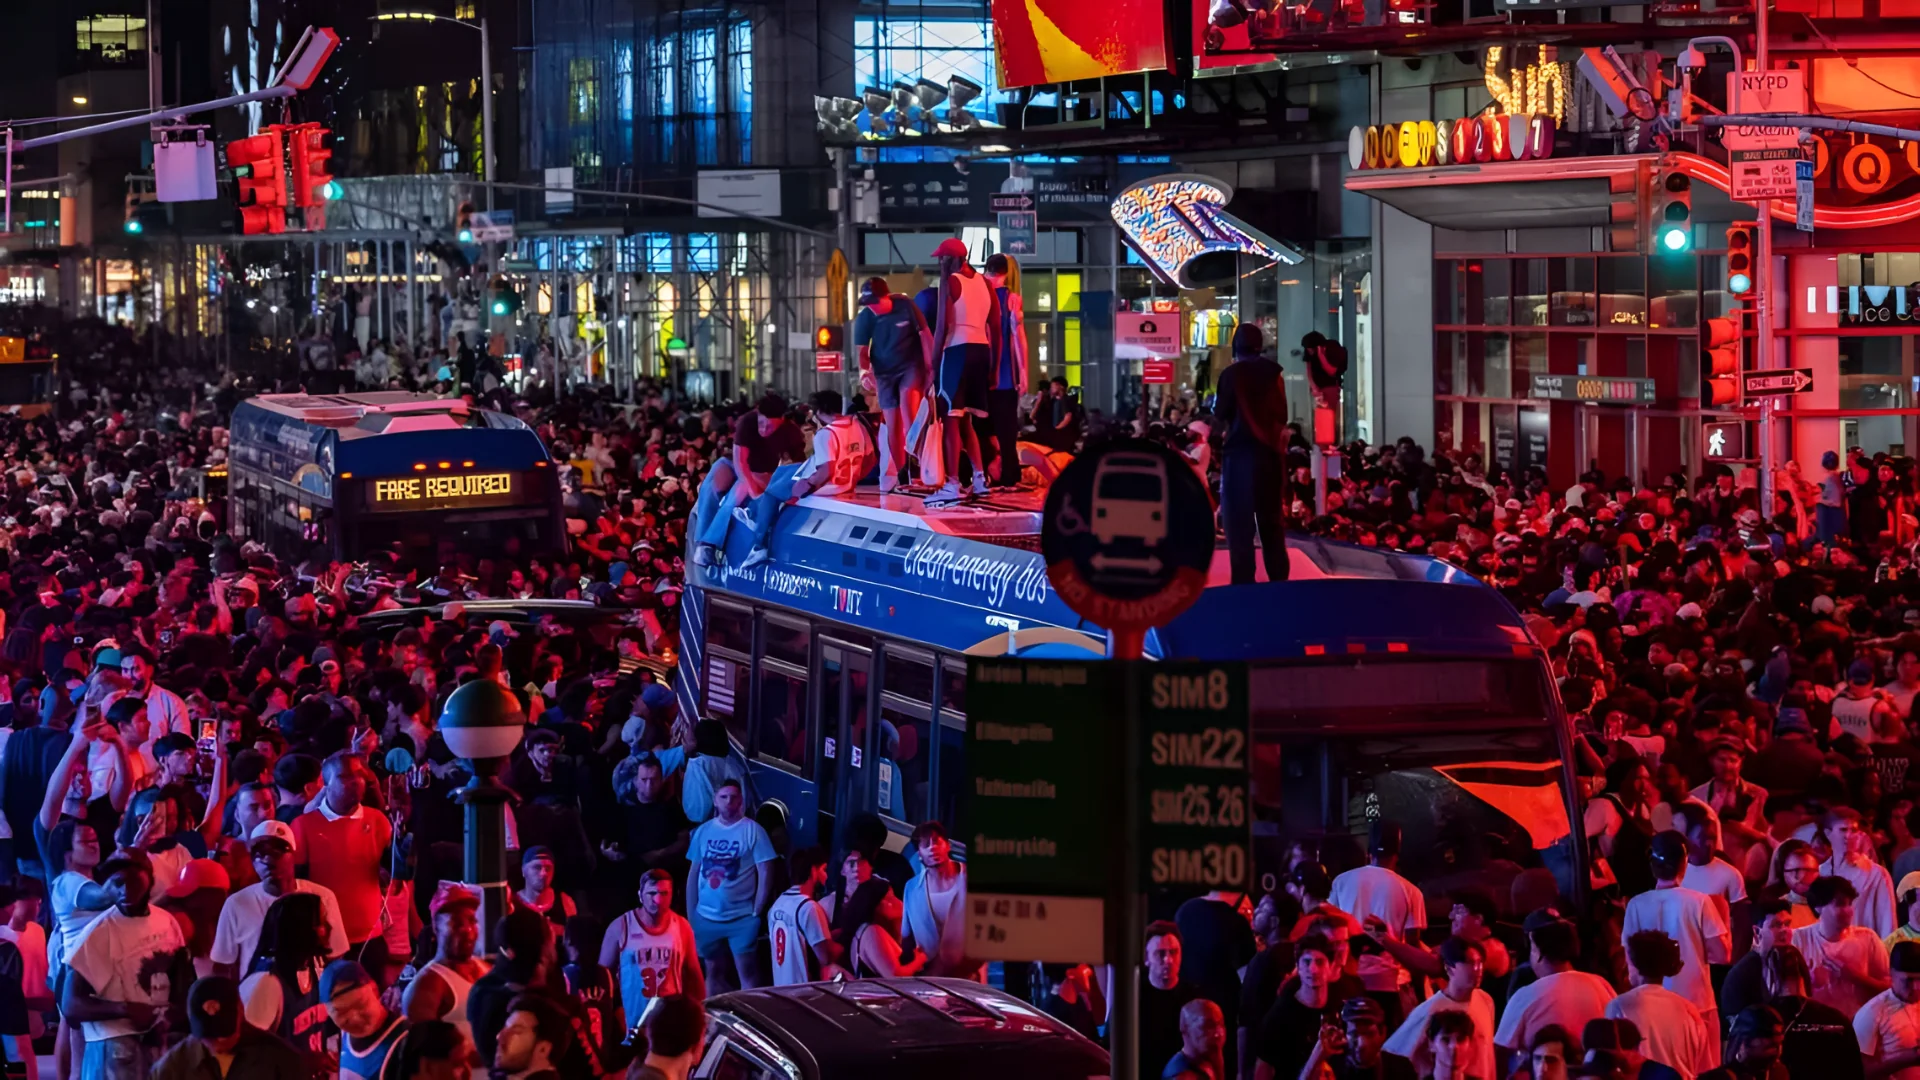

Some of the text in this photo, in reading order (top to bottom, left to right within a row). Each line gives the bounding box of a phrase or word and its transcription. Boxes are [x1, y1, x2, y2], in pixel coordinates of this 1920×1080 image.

[1742, 75, 1789, 91] NYPD
[1852, 151, 1882, 186] Q
[376, 473, 511, 502] FARE REQUIRED
[904, 533, 1048, 608] clean-energy bus
[1152, 668, 1229, 711] SIM8
[1151, 727, 1245, 769] SIM22
[1151, 842, 1245, 887] SIM30
